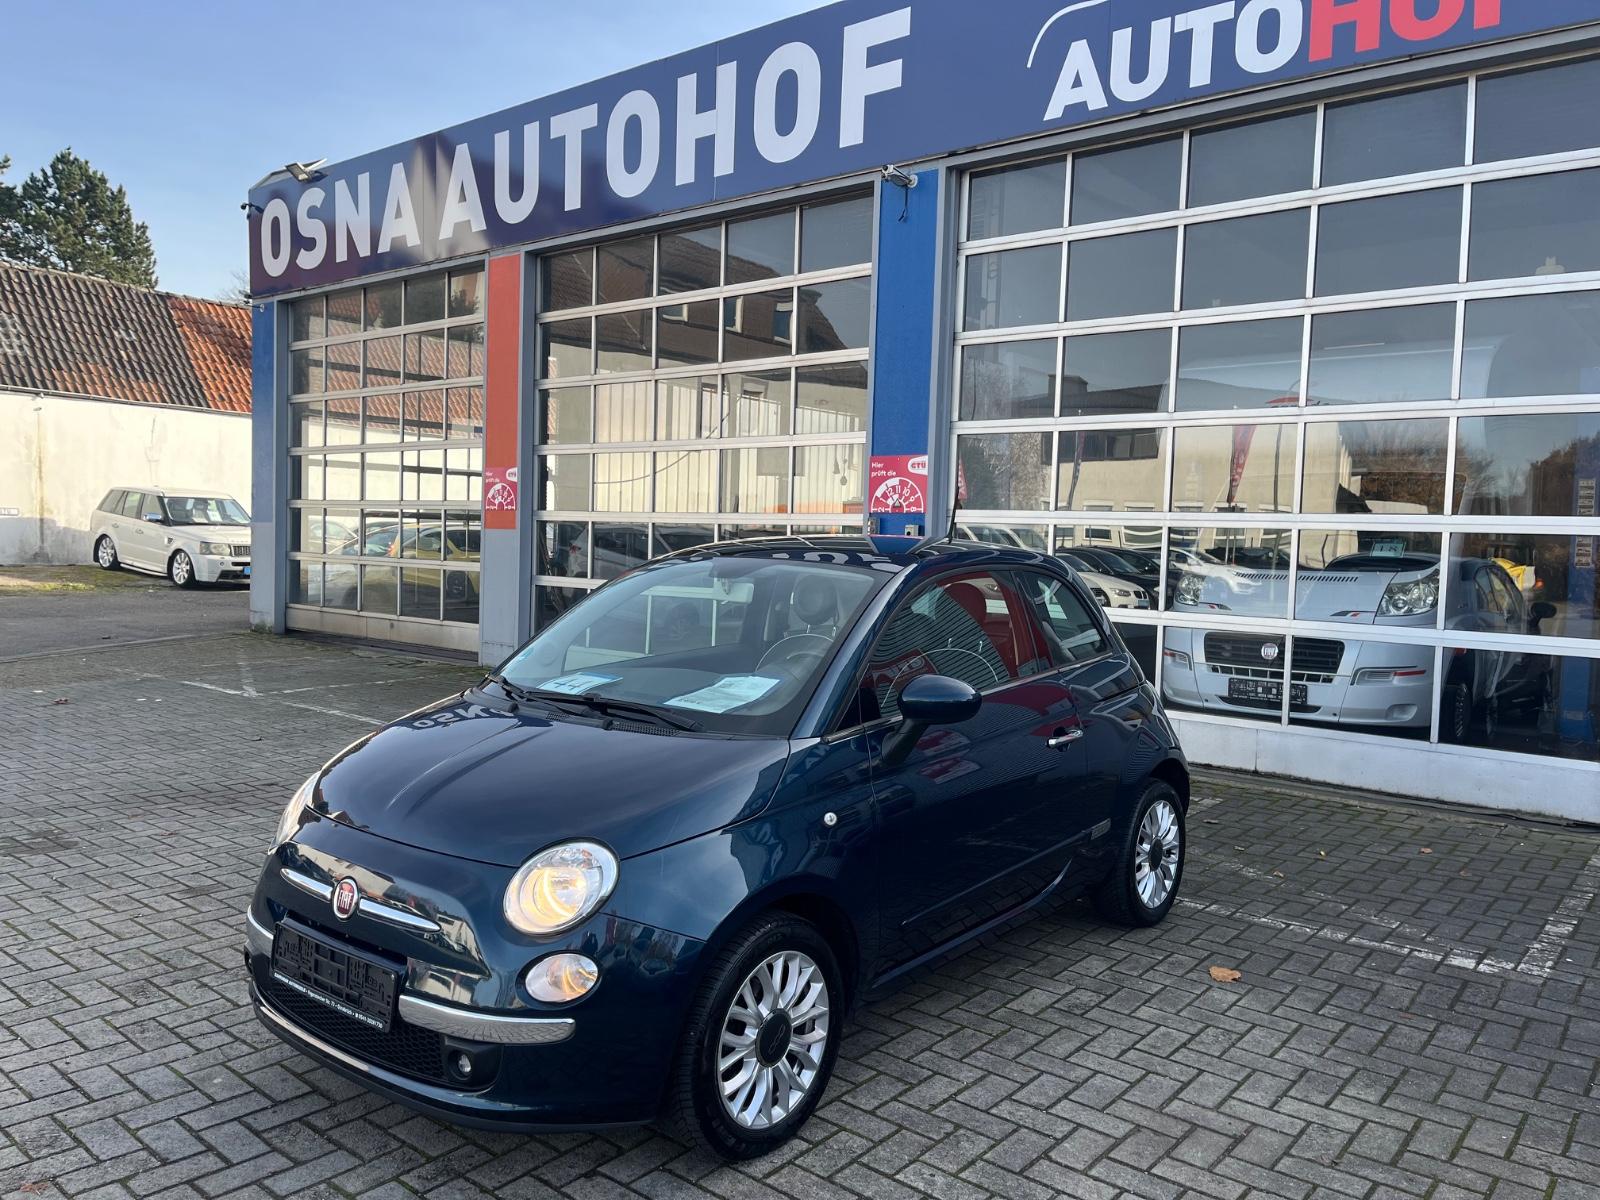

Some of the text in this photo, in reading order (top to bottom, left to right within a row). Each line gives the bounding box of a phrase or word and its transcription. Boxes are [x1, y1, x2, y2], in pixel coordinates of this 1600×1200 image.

[260, 6, 912, 278] OSNA AUTOHOF
[337, 889, 354, 911] FIAT
